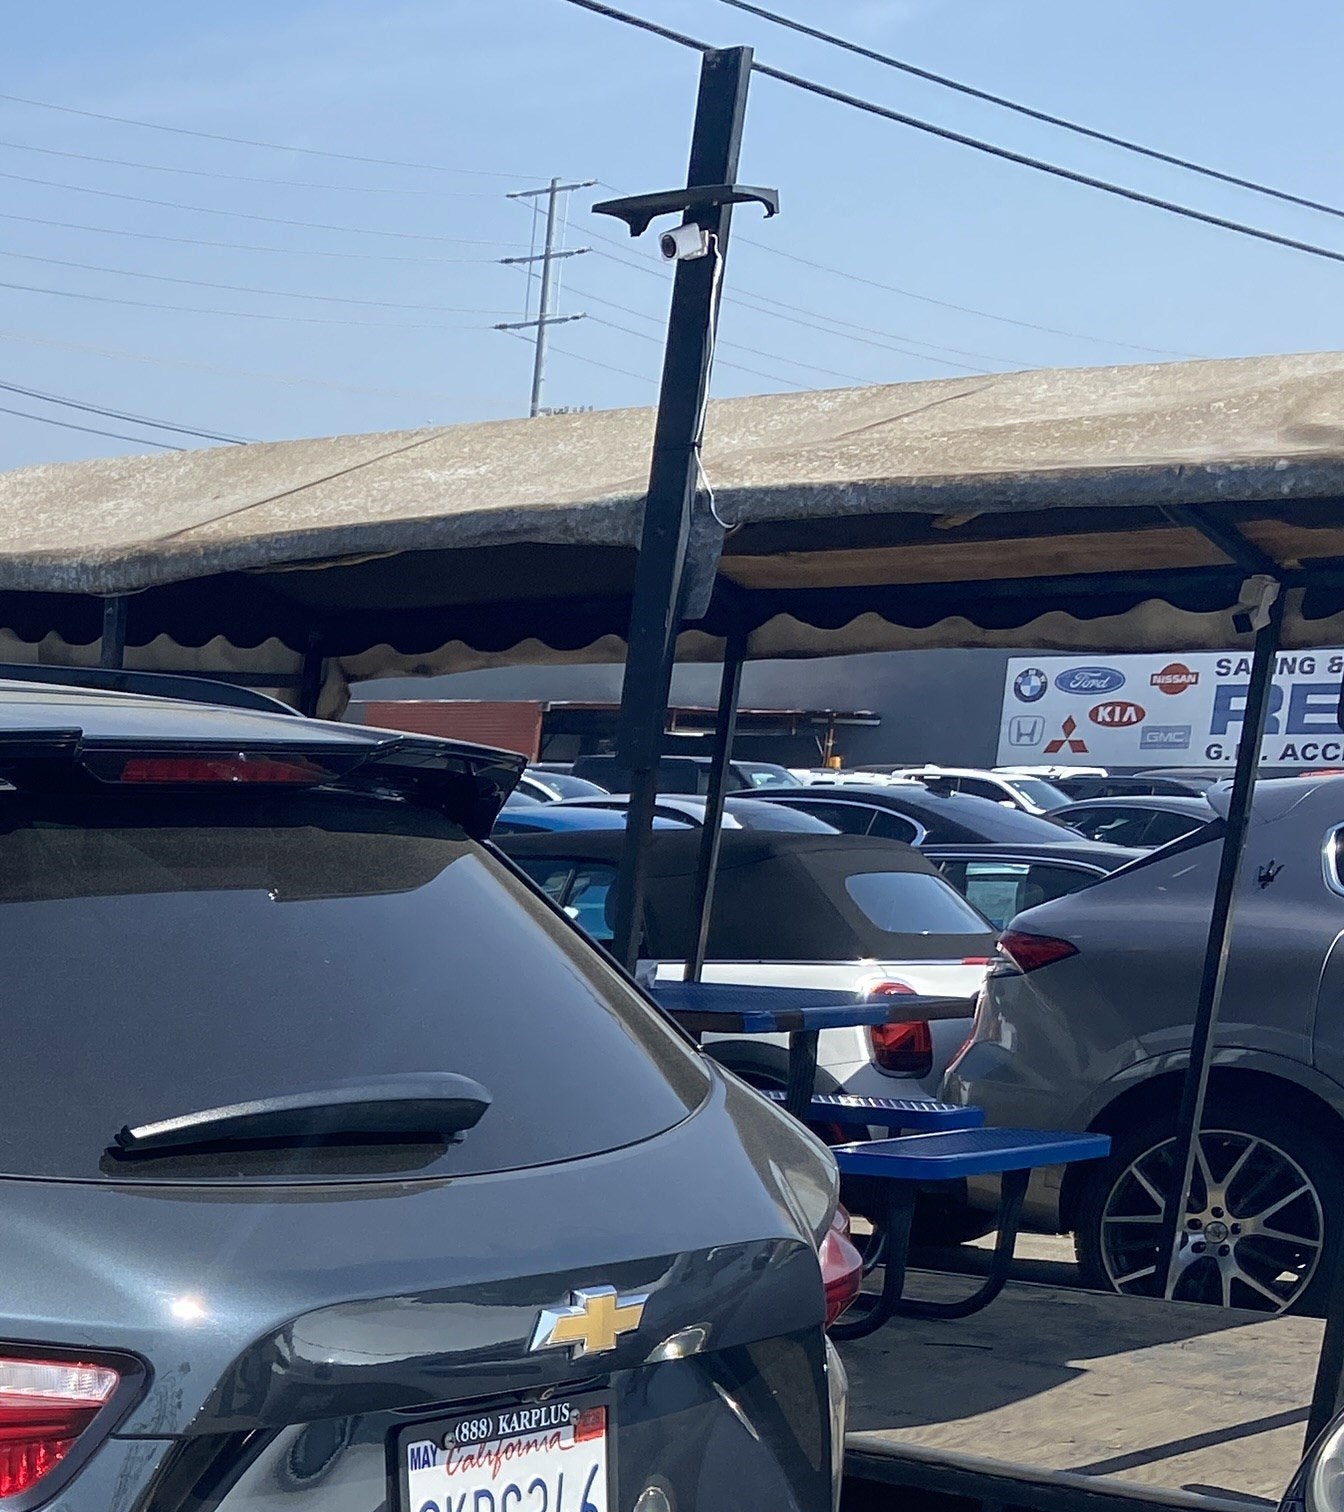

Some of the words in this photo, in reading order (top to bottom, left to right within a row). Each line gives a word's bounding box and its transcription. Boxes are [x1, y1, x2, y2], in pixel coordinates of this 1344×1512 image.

[1069, 671, 1111, 689] Ford
[1152, 673, 1197, 685] NISSAN
[1096, 705, 1139, 723] KIA
[1145, 731, 1186, 743] GMC
[1278, 742, 1344, 761] ACC
[454, 1416, 494, 1443] (888)
[497, 1402, 571, 1435] KARPLUS
[410, 1444, 438, 1471] MAY
[445, 1430, 575, 1481] California
